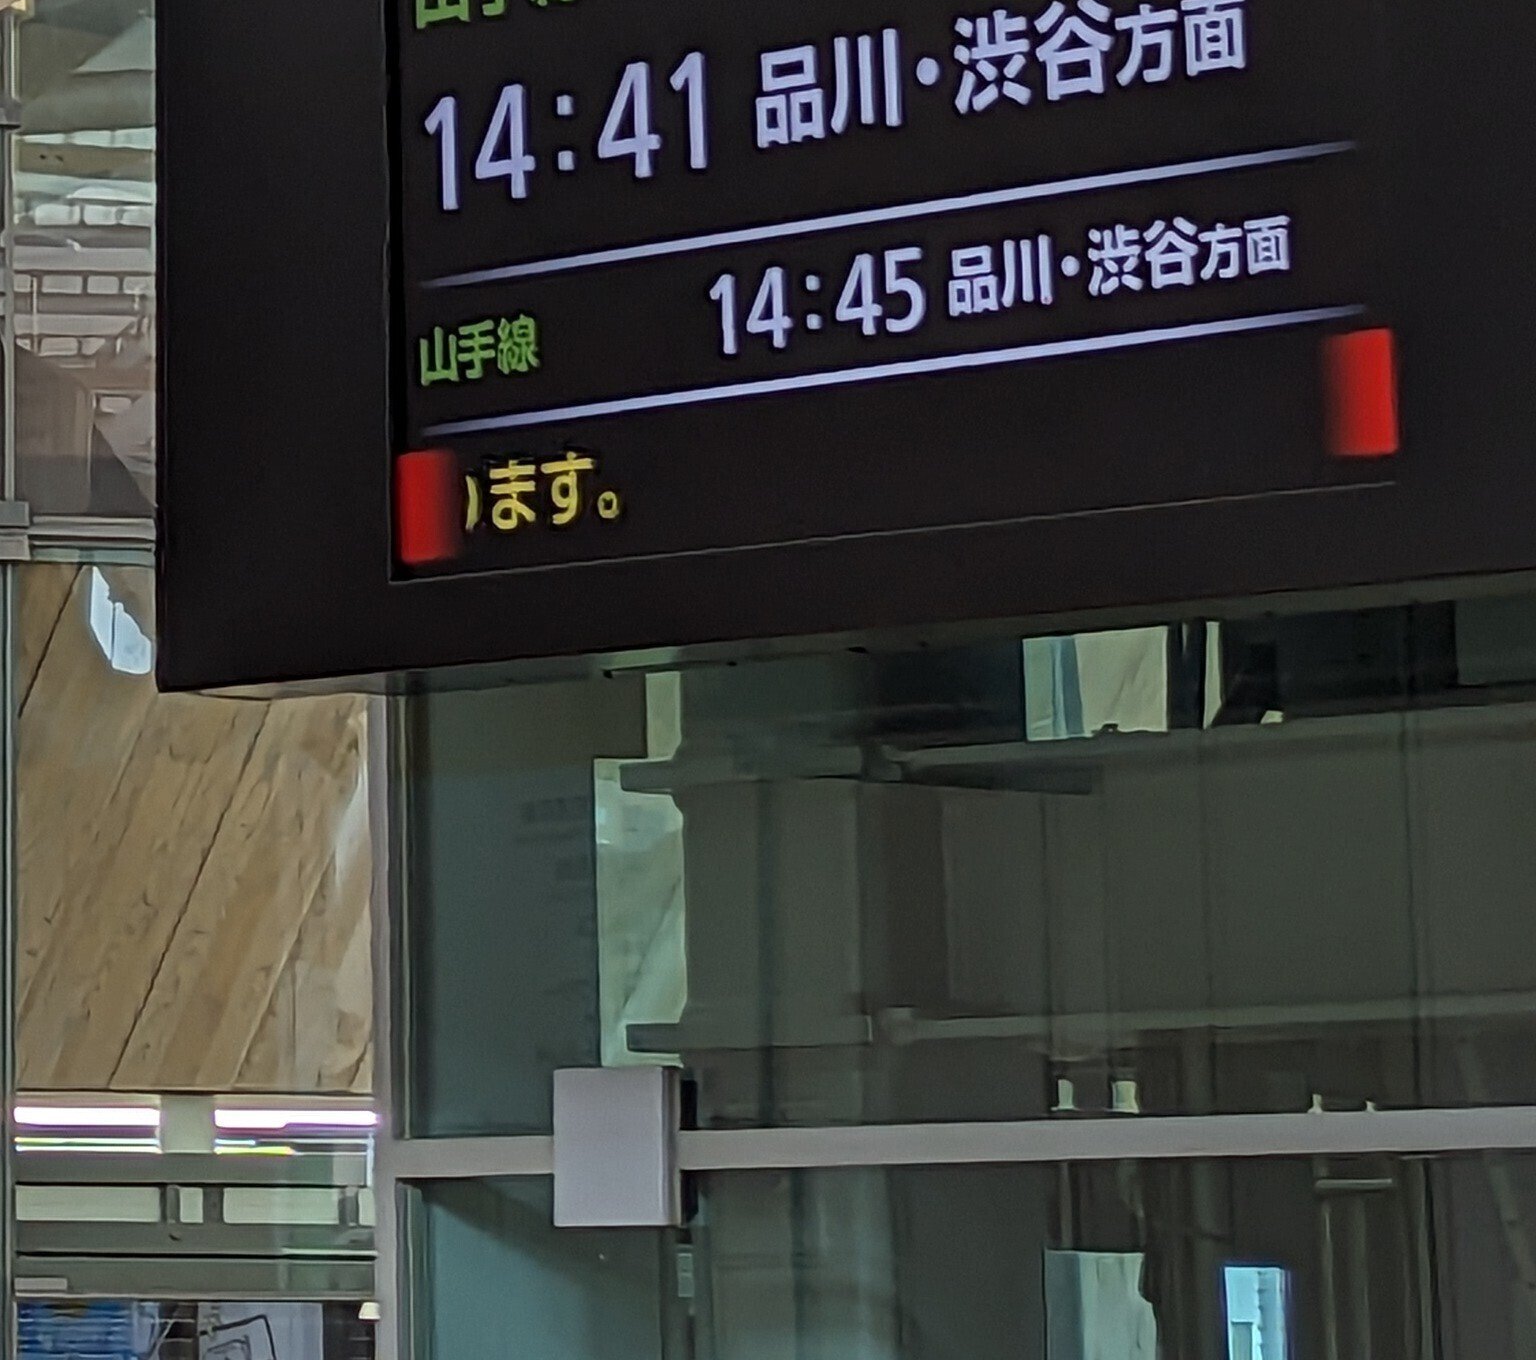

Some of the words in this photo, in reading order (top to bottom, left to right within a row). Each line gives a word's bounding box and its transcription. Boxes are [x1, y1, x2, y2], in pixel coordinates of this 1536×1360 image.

[423, 52, 709, 212] 14:41
[420, 314, 541, 386] 山手線
[709, 248, 925, 355] 14:45
[948, 214, 1291, 317] 品川・渋谷方面
